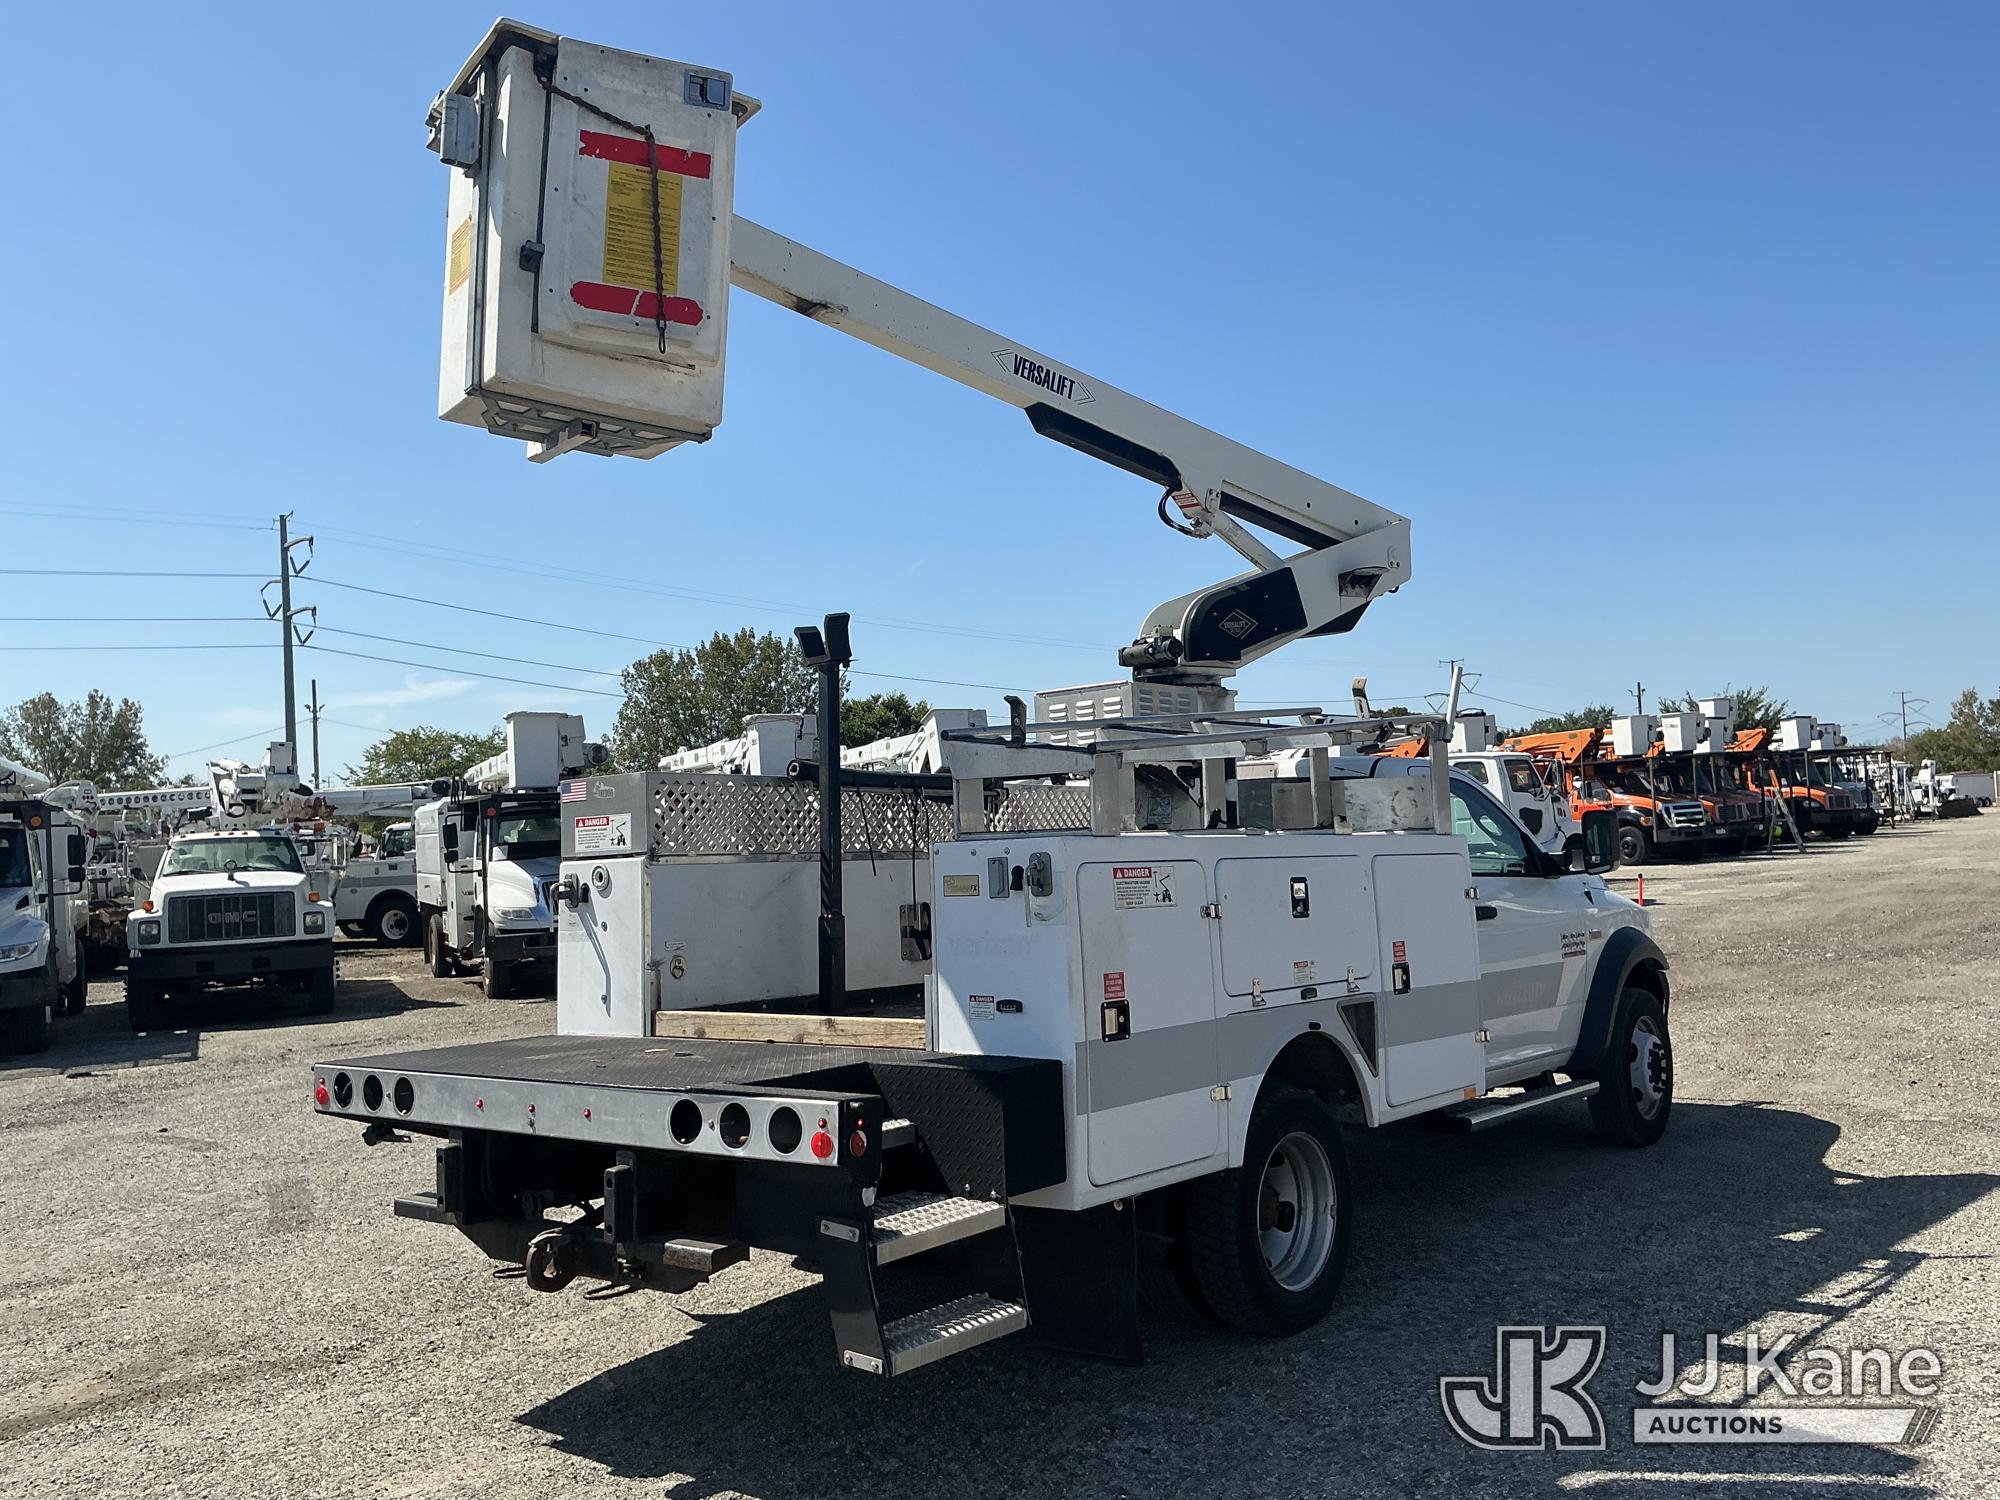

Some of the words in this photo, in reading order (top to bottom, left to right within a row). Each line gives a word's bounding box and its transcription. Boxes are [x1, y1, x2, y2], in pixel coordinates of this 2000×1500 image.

[1013, 354, 1076, 399] VERSALIFT
[585, 818, 607, 826] DANGER
[1123, 868, 1150, 877] DANGER
[208, 911, 256, 924] GMC
